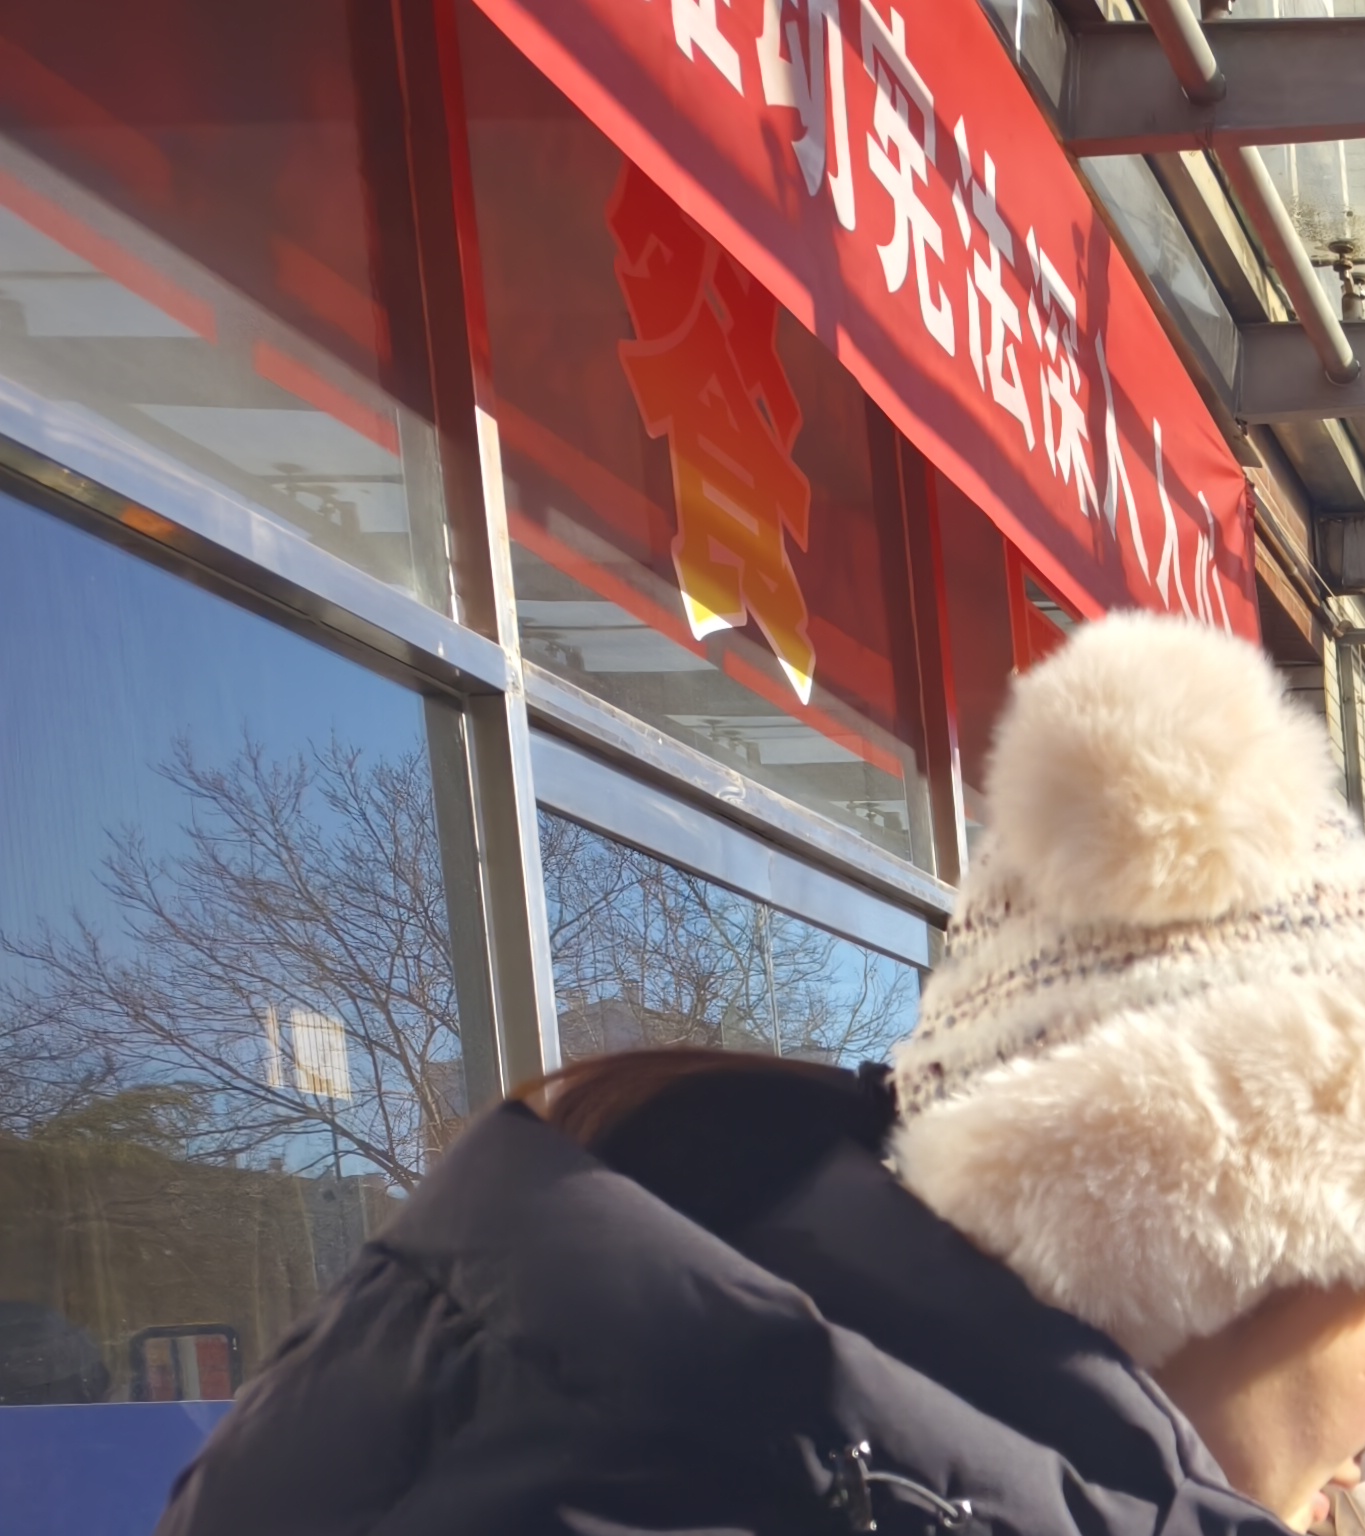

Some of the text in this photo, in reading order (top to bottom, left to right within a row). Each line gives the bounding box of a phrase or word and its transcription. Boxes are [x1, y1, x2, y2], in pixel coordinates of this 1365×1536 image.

[671, 0, 1233, 638] 动宪法深入人心
